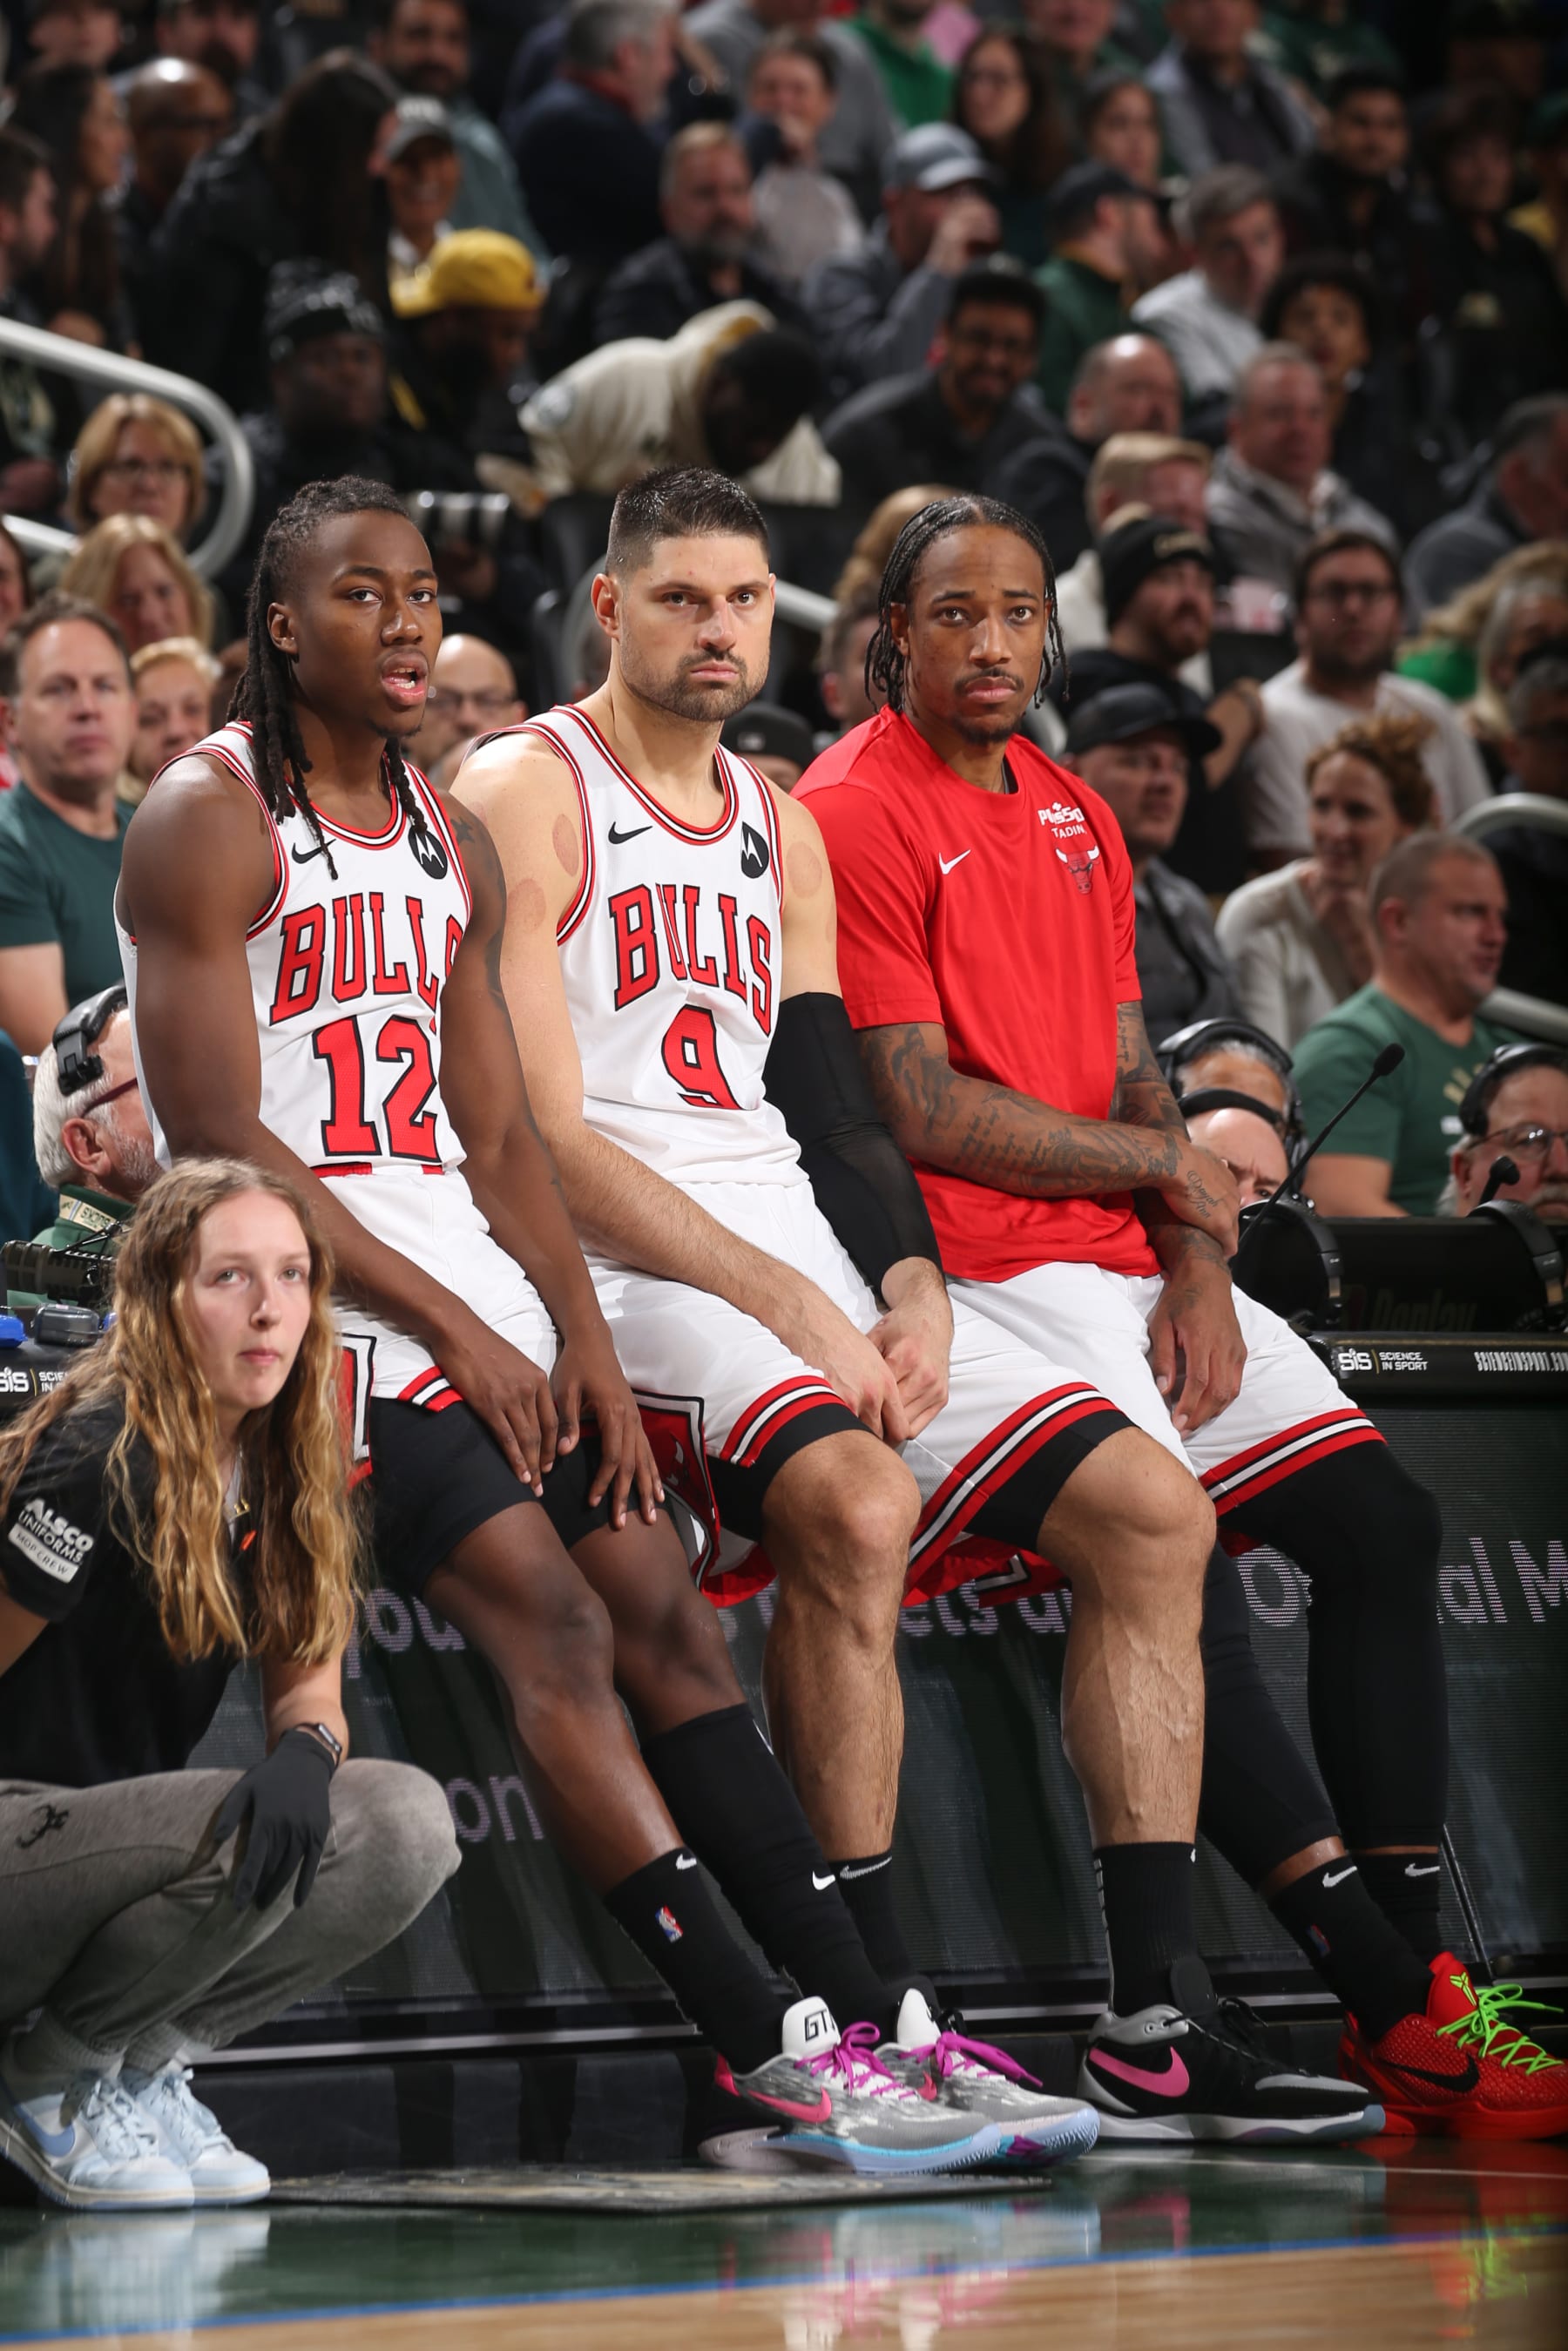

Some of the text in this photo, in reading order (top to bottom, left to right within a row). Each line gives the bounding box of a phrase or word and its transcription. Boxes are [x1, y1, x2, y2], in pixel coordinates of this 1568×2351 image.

[608, 882, 771, 1037] BULLS
[660, 1003, 744, 1111] 9
[312, 1015, 442, 1163] 12
[38, 1371, 68, 1382] SCIE
[1378, 1351, 1424, 1361] SCIENCE
[1382, 1361, 1429, 1370] IN SPORT
[17, 1509, 84, 1564] UNIFORMS
[24, 1498, 94, 1552] ALSCO
[16, 1533, 68, 1575] MOP CREW
